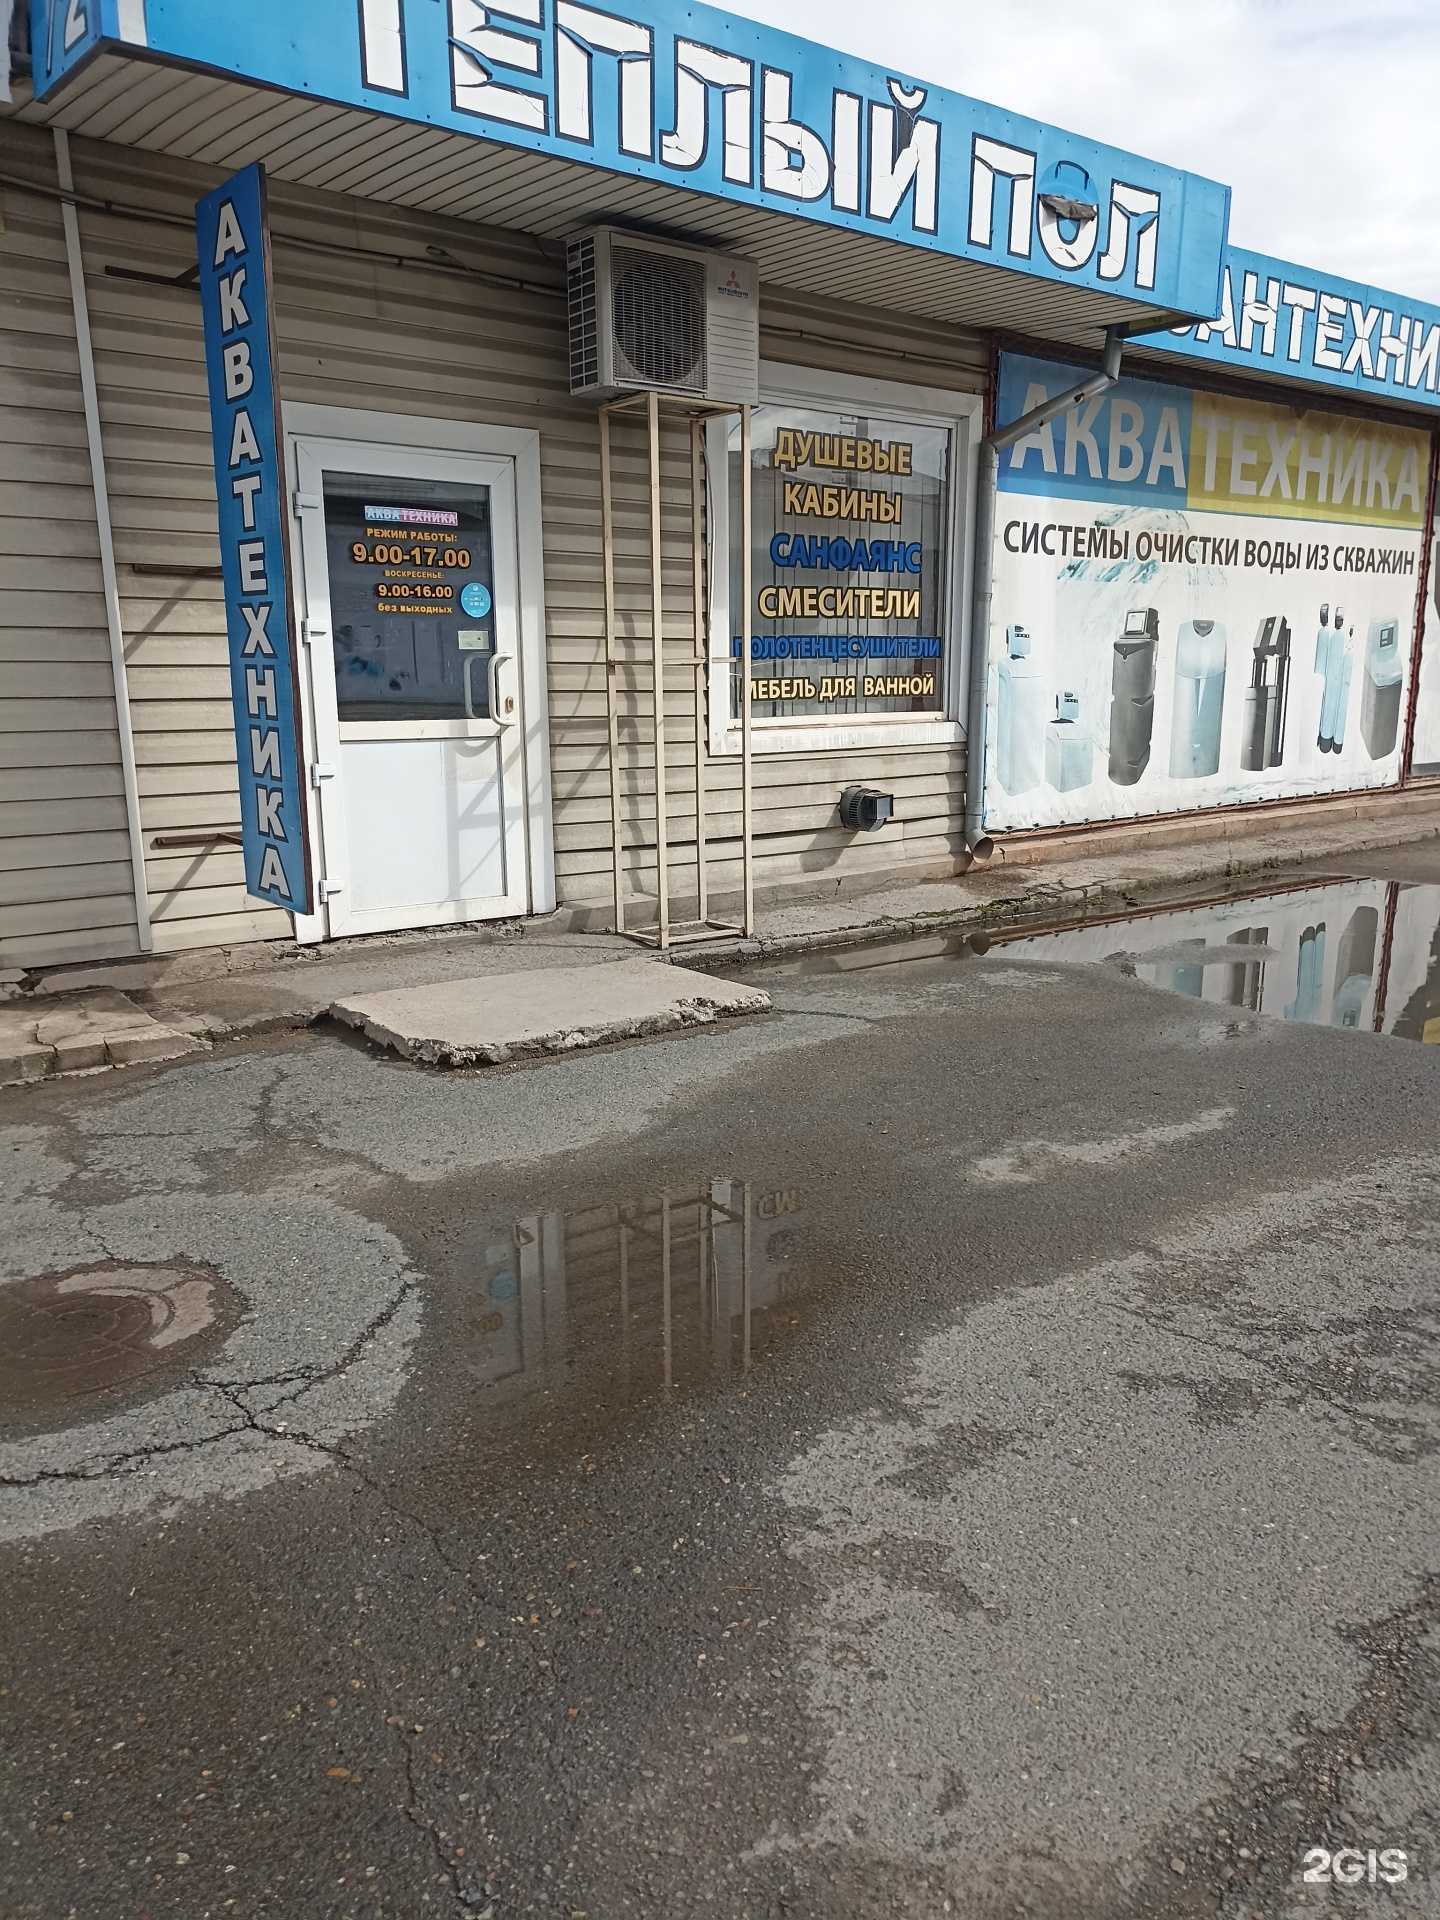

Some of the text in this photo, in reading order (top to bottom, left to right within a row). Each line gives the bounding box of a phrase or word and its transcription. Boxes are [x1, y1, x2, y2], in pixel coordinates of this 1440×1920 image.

[967, 132, 1161, 291] ПОЛ
[1167, 265, 1440, 394] АНТЕХНИ
[773, 427, 912, 476] ДУШЕВЫЕ
[783, 482, 902, 523] КАБИНЫ
[212, 200, 293, 901] АКВАТЕХНИКА
[351, 542, 472, 569] 9.00-17.00
[366, 527, 458, 543] РЕЖИМ РАБОТЫ:
[770, 532, 922, 574] САНФАЯНС
[1003, 520, 1415, 576] СИСТЕМЫ ОЧИСТКИ ВОДЫ ИЗ СКВАЖИН
[376, 583, 454, 600] 9.00-16.00
[377, 602, 453, 614] без выходных
[758, 586, 921, 619] СМЕСИТЕЛИ
[818, 677, 856, 702] ДЛЯ
[863, 673, 935, 697] ВАННОЙ
